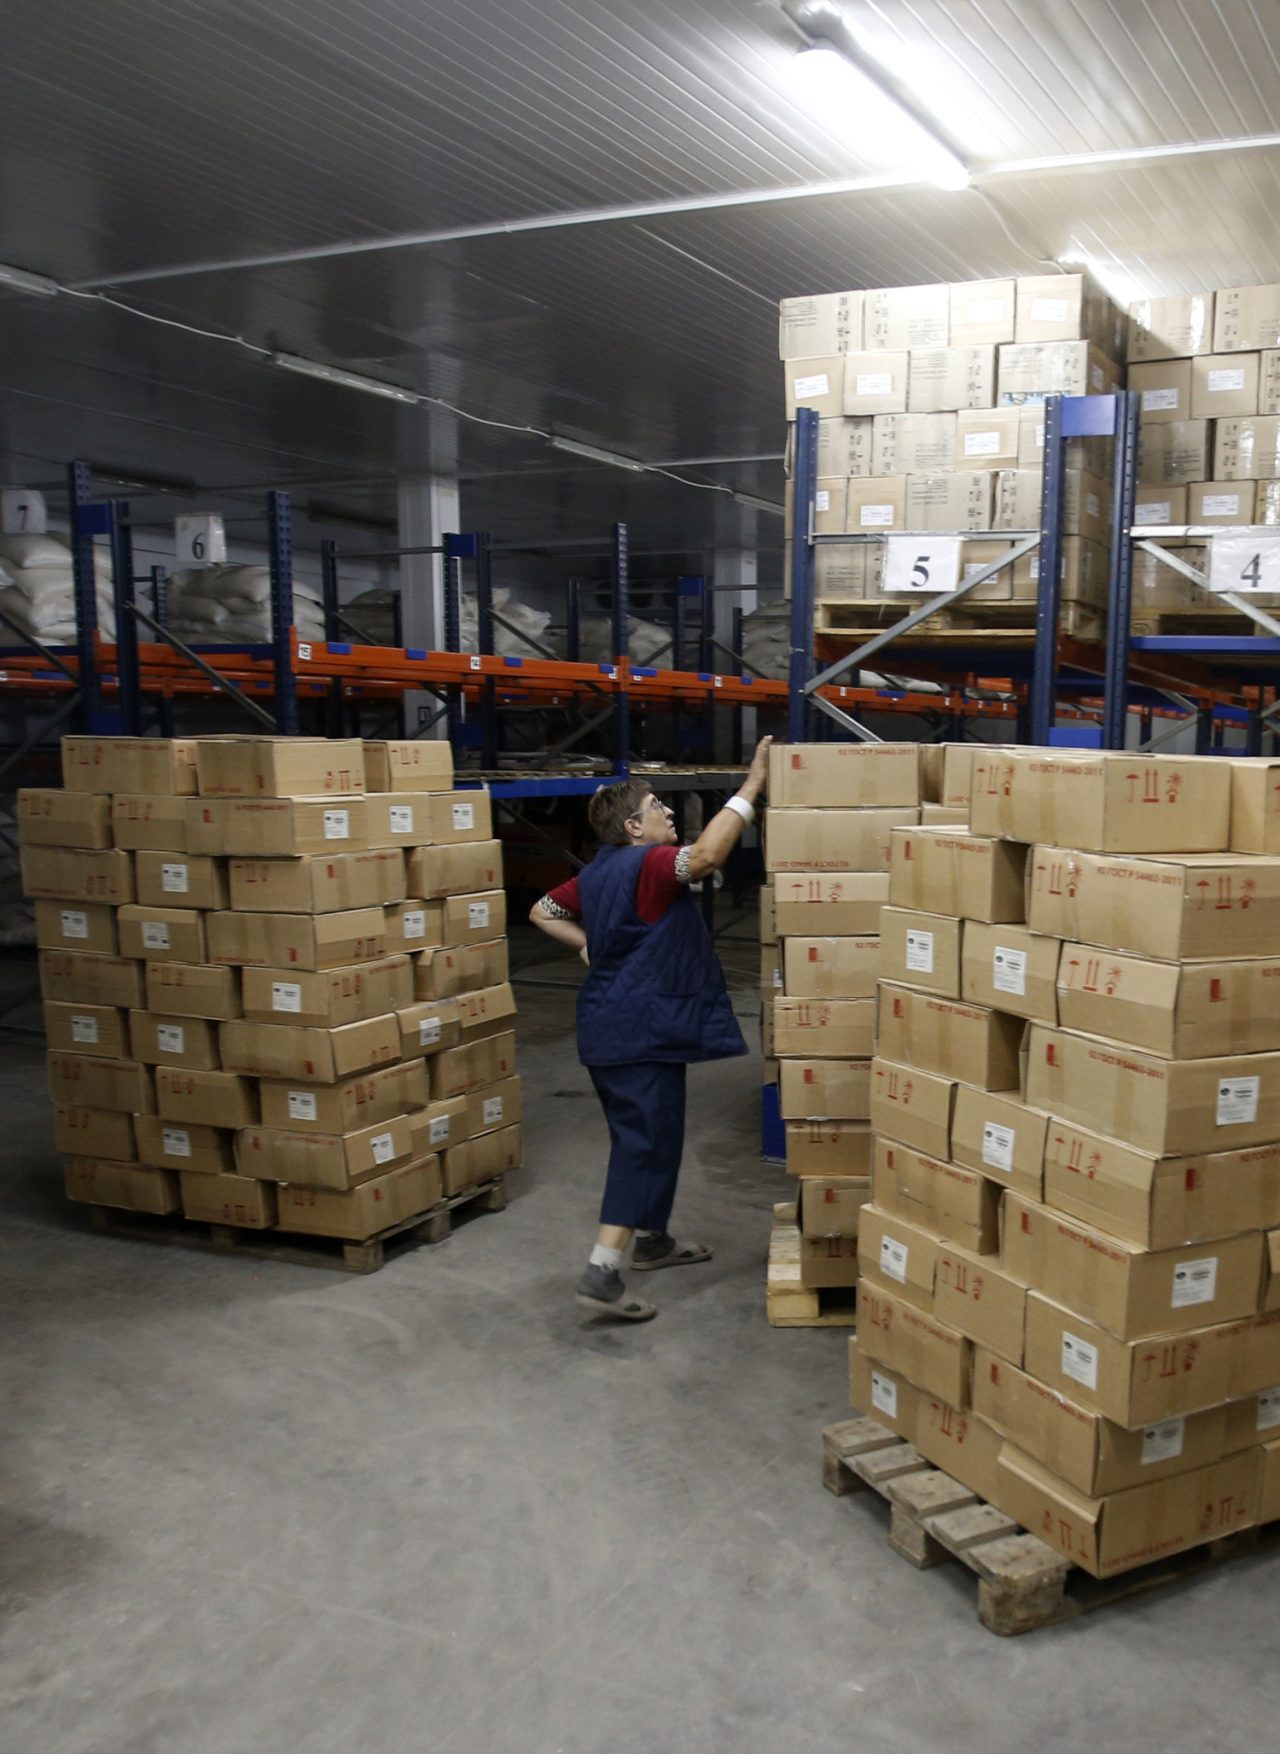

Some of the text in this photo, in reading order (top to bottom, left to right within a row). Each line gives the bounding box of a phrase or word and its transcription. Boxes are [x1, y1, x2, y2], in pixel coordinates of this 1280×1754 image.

[17, 504, 29, 531] 7
[192, 532, 205, 560] 6
[910, 556, 931, 588] 5
[1240, 553, 1262, 588] 4
